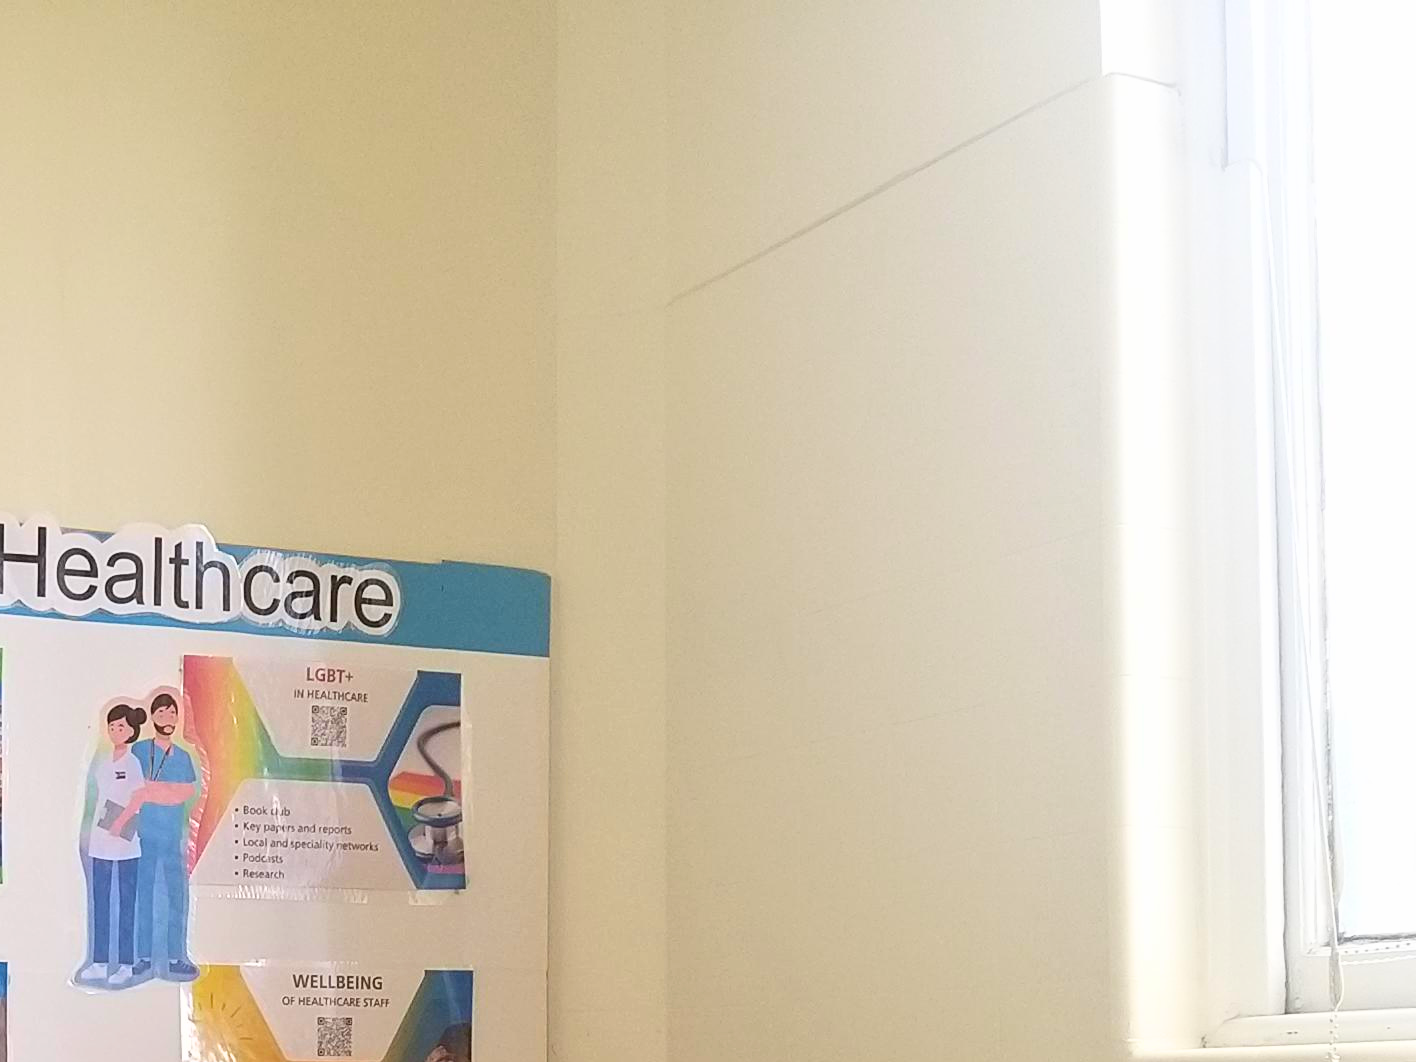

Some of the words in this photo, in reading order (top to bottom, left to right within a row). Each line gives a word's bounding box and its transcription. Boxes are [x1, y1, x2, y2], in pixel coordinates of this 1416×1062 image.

[307, 667, 353, 684] LGBT+
[294, 689, 304, 698] IN
[307, 688, 368, 703] HEALTHCARE
[243, 805, 268, 815] Book
[243, 821, 261, 833] Key
[297, 824, 316, 833] and
[318, 826, 352, 836] reports
[243, 837, 267, 849] Local
[270, 837, 288, 848] and
[290, 839, 336, 853] speciality
[336, 842, 378, 851] networks
[243, 869, 284, 879] Research
[293, 974, 382, 990] WELLBEING
[282, 996, 295, 1005] OF
[298, 996, 361, 1007] HEALTHCARE
[363, 998, 389, 1007] STAFF
